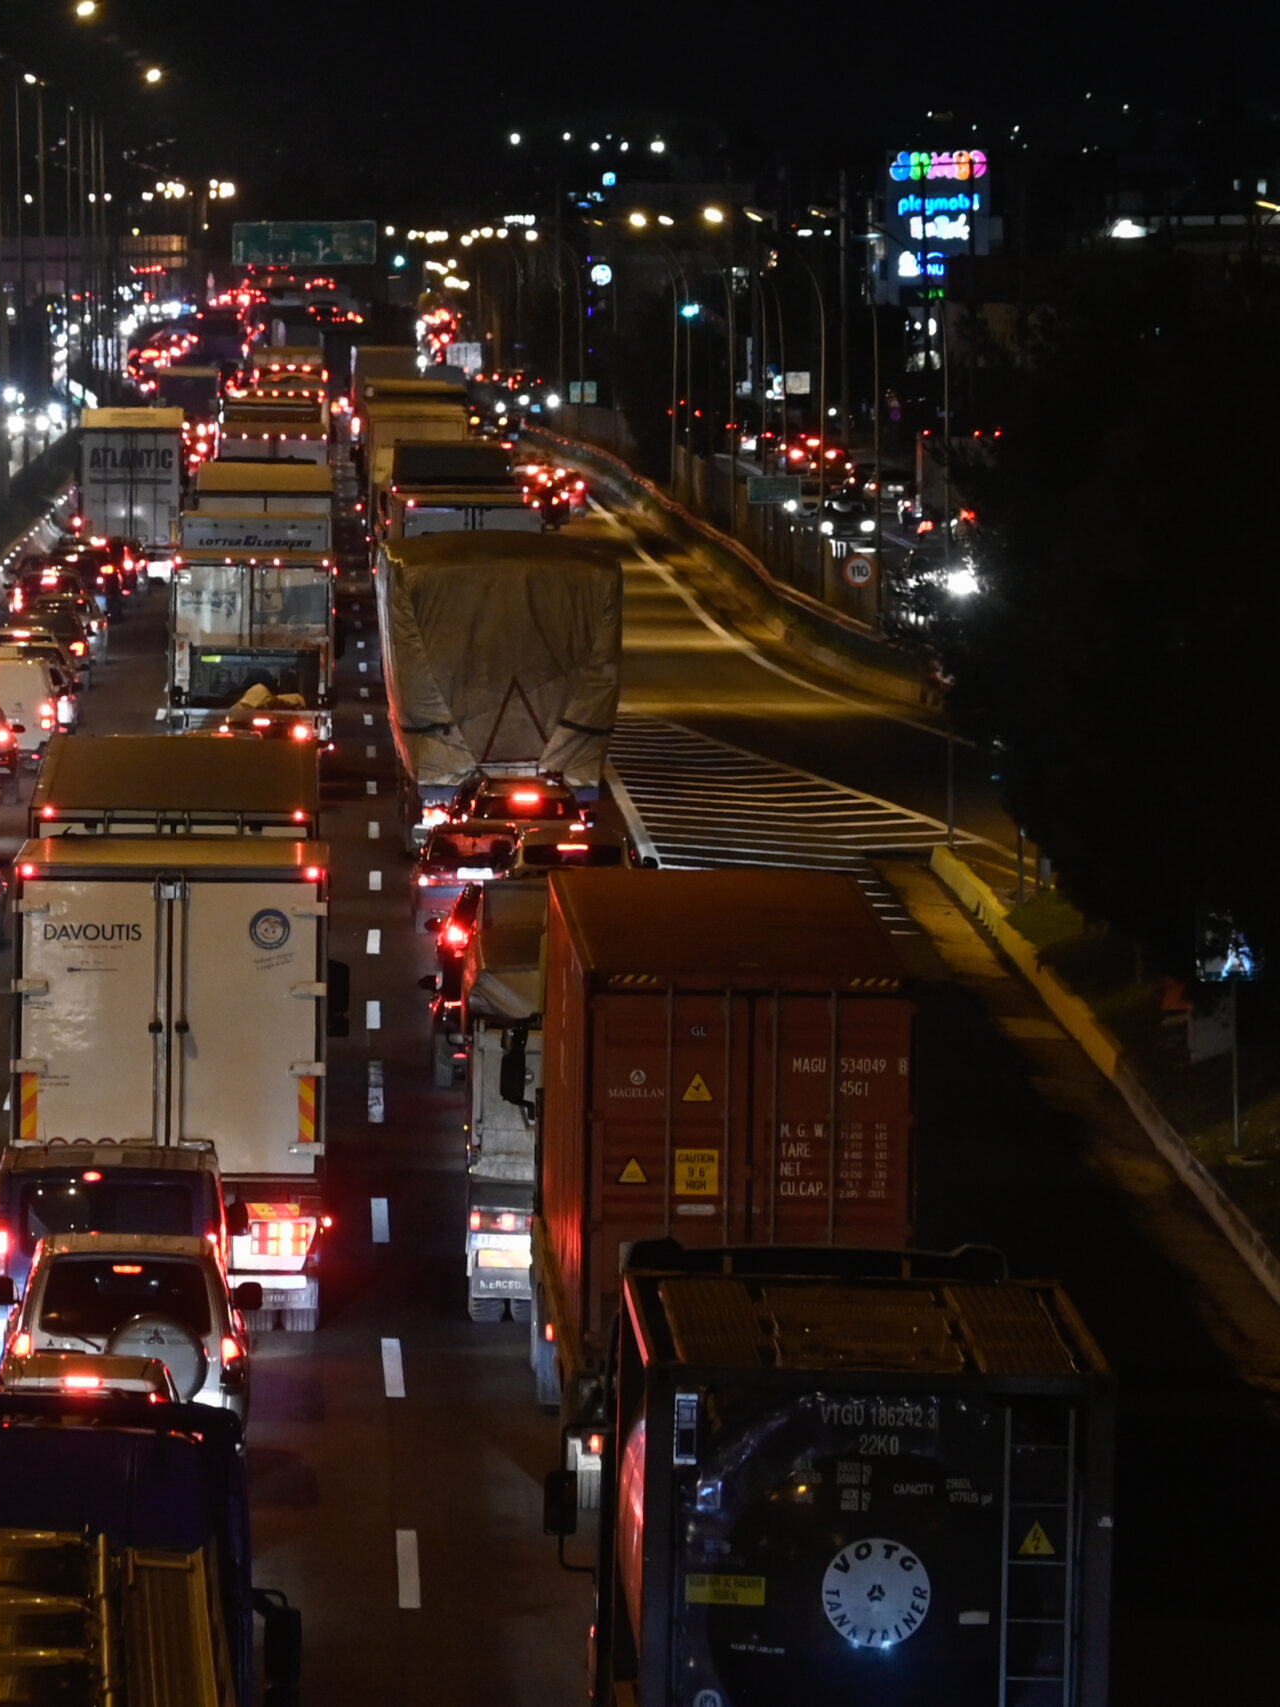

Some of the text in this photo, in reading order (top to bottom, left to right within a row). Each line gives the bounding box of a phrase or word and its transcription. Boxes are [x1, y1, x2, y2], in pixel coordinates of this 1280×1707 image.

[898, 193, 980, 216] playmobl
[90, 448, 172, 469] ATLANTIC
[851, 565, 869, 577] 110
[44, 923, 142, 941] DAVOUTIS
[691, 1025, 707, 1037] GL
[792, 1057, 826, 1073] MAGU
[839, 1057, 887, 1074] 534049
[608, 1088, 665, 1098] MAGELLAN
[839, 1081, 869, 1097] 45G1
[678, 1153, 715, 1163] CAUTION
[781, 1142, 812, 1158] TARE
[779, 1161, 801, 1177] NET
[685, 1180, 707, 1191] HIGH
[821, 1403, 865, 1426] VTGU
[869, 1405, 923, 1428] 186242
[892, 1483, 935, 1496] CAPACITY
[833, 1542, 918, 1574] VOTG
